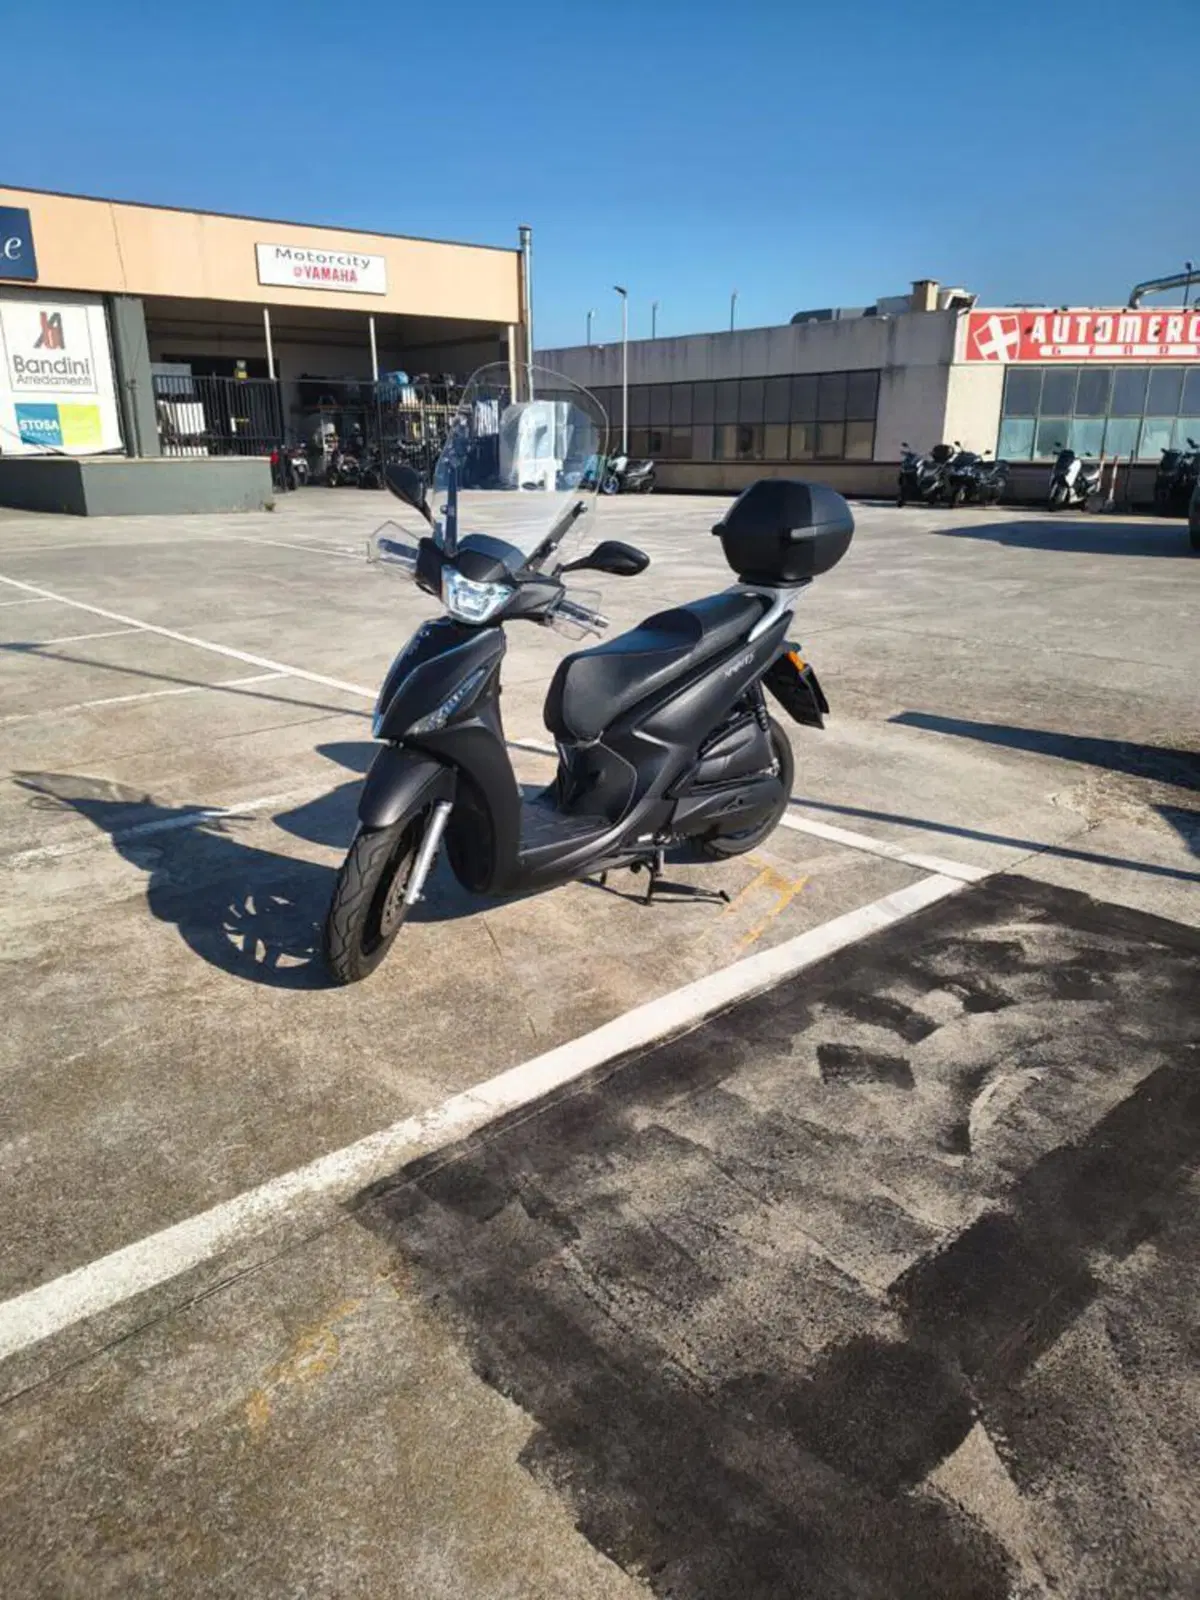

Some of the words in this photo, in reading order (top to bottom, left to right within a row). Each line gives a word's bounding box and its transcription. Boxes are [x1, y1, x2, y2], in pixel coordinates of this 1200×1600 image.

[0, 236, 22, 260] e
[275, 247, 371, 270] Motorcity
[304, 265, 357, 284] YAMAHA
[13, 354, 90, 375] Bandini
[16, 374, 92, 387] Arredamenti
